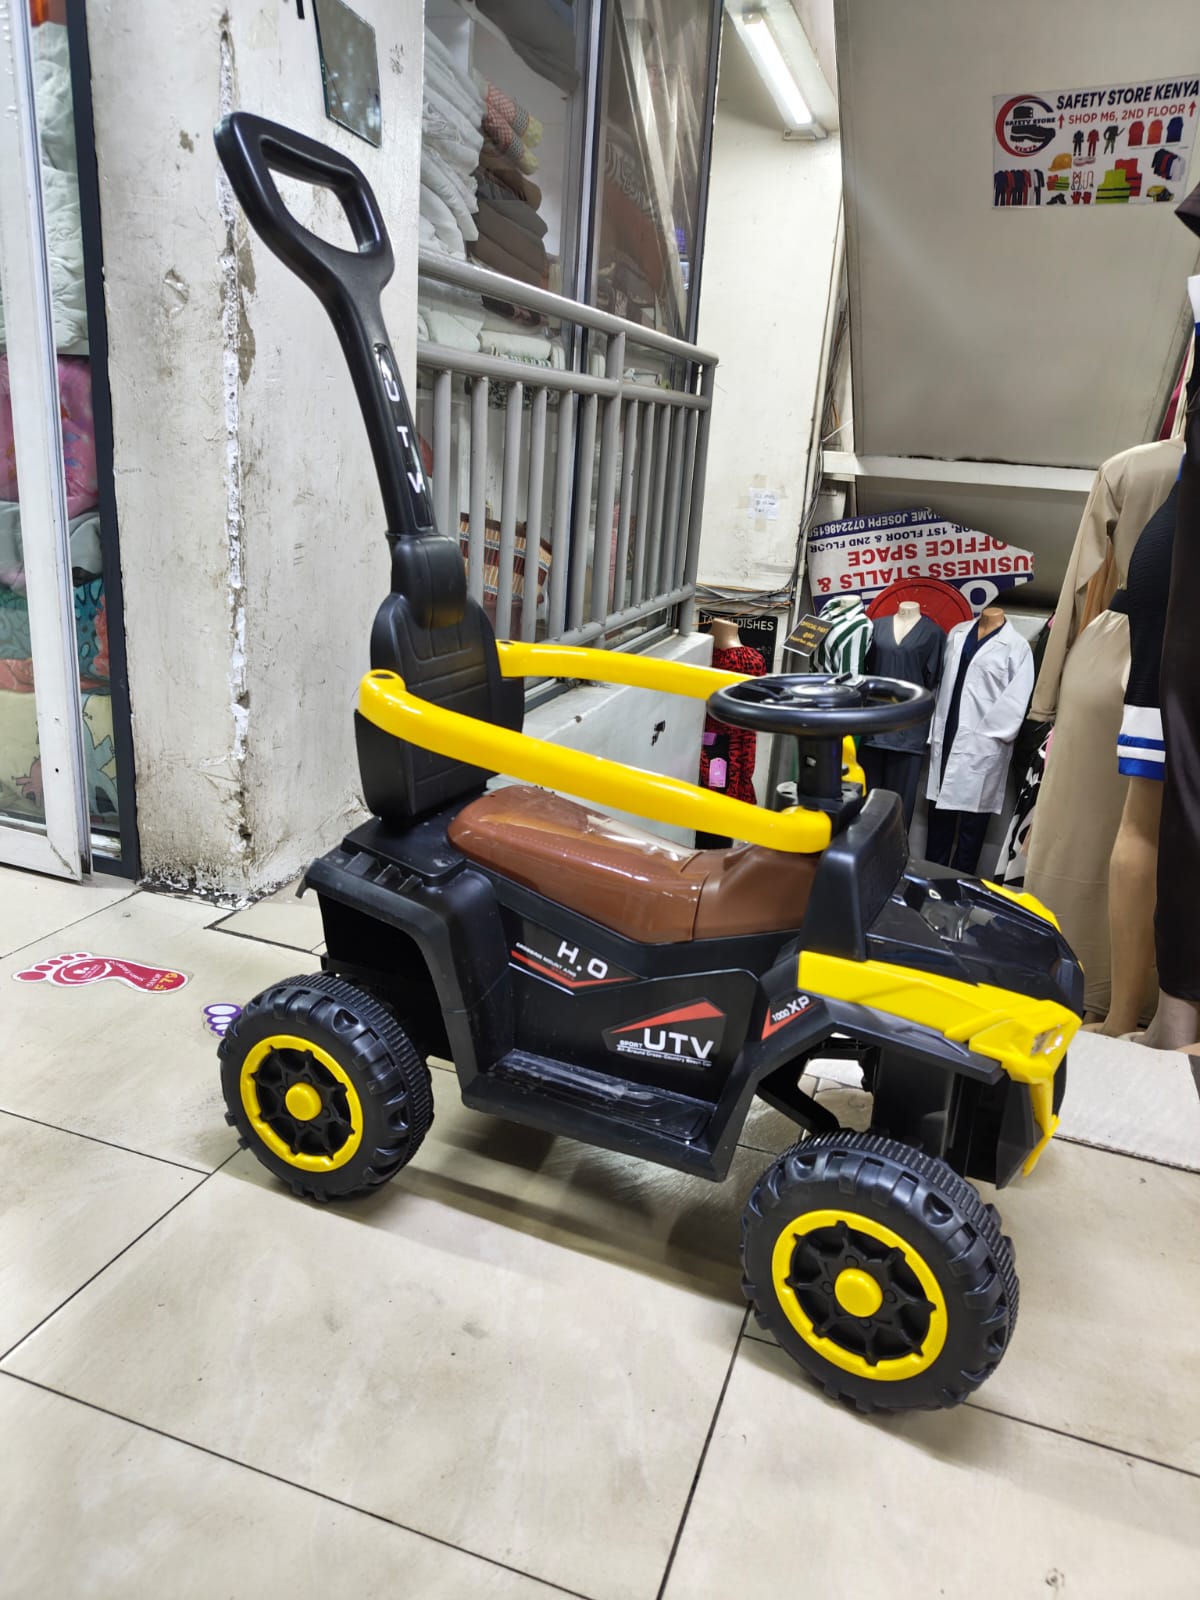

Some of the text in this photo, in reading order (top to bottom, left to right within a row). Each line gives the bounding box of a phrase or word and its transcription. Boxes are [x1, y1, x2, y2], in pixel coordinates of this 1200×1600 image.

[1056, 80, 1200, 110] SAFETY STORE KENYA
[1068, 104, 1186, 125] SHOP M6, 2ND FLOOR
[867, 513, 909, 528] JOSEPH
[874, 535, 882, 544] &
[885, 529, 923, 542] FLOOR
[926, 527, 948, 537] 1ST
[809, 540, 846, 554] FLOOR
[848, 537, 871, 547] 2ND
[847, 535, 1008, 567] OFFICE SPACE
[816, 577, 832, 593] &
[839, 566, 920, 590] STALLS
[738, 617, 774, 631] DISHES
[771, 995, 810, 1022] 1000 XP
[619, 1027, 714, 1059] SPORT UTV
